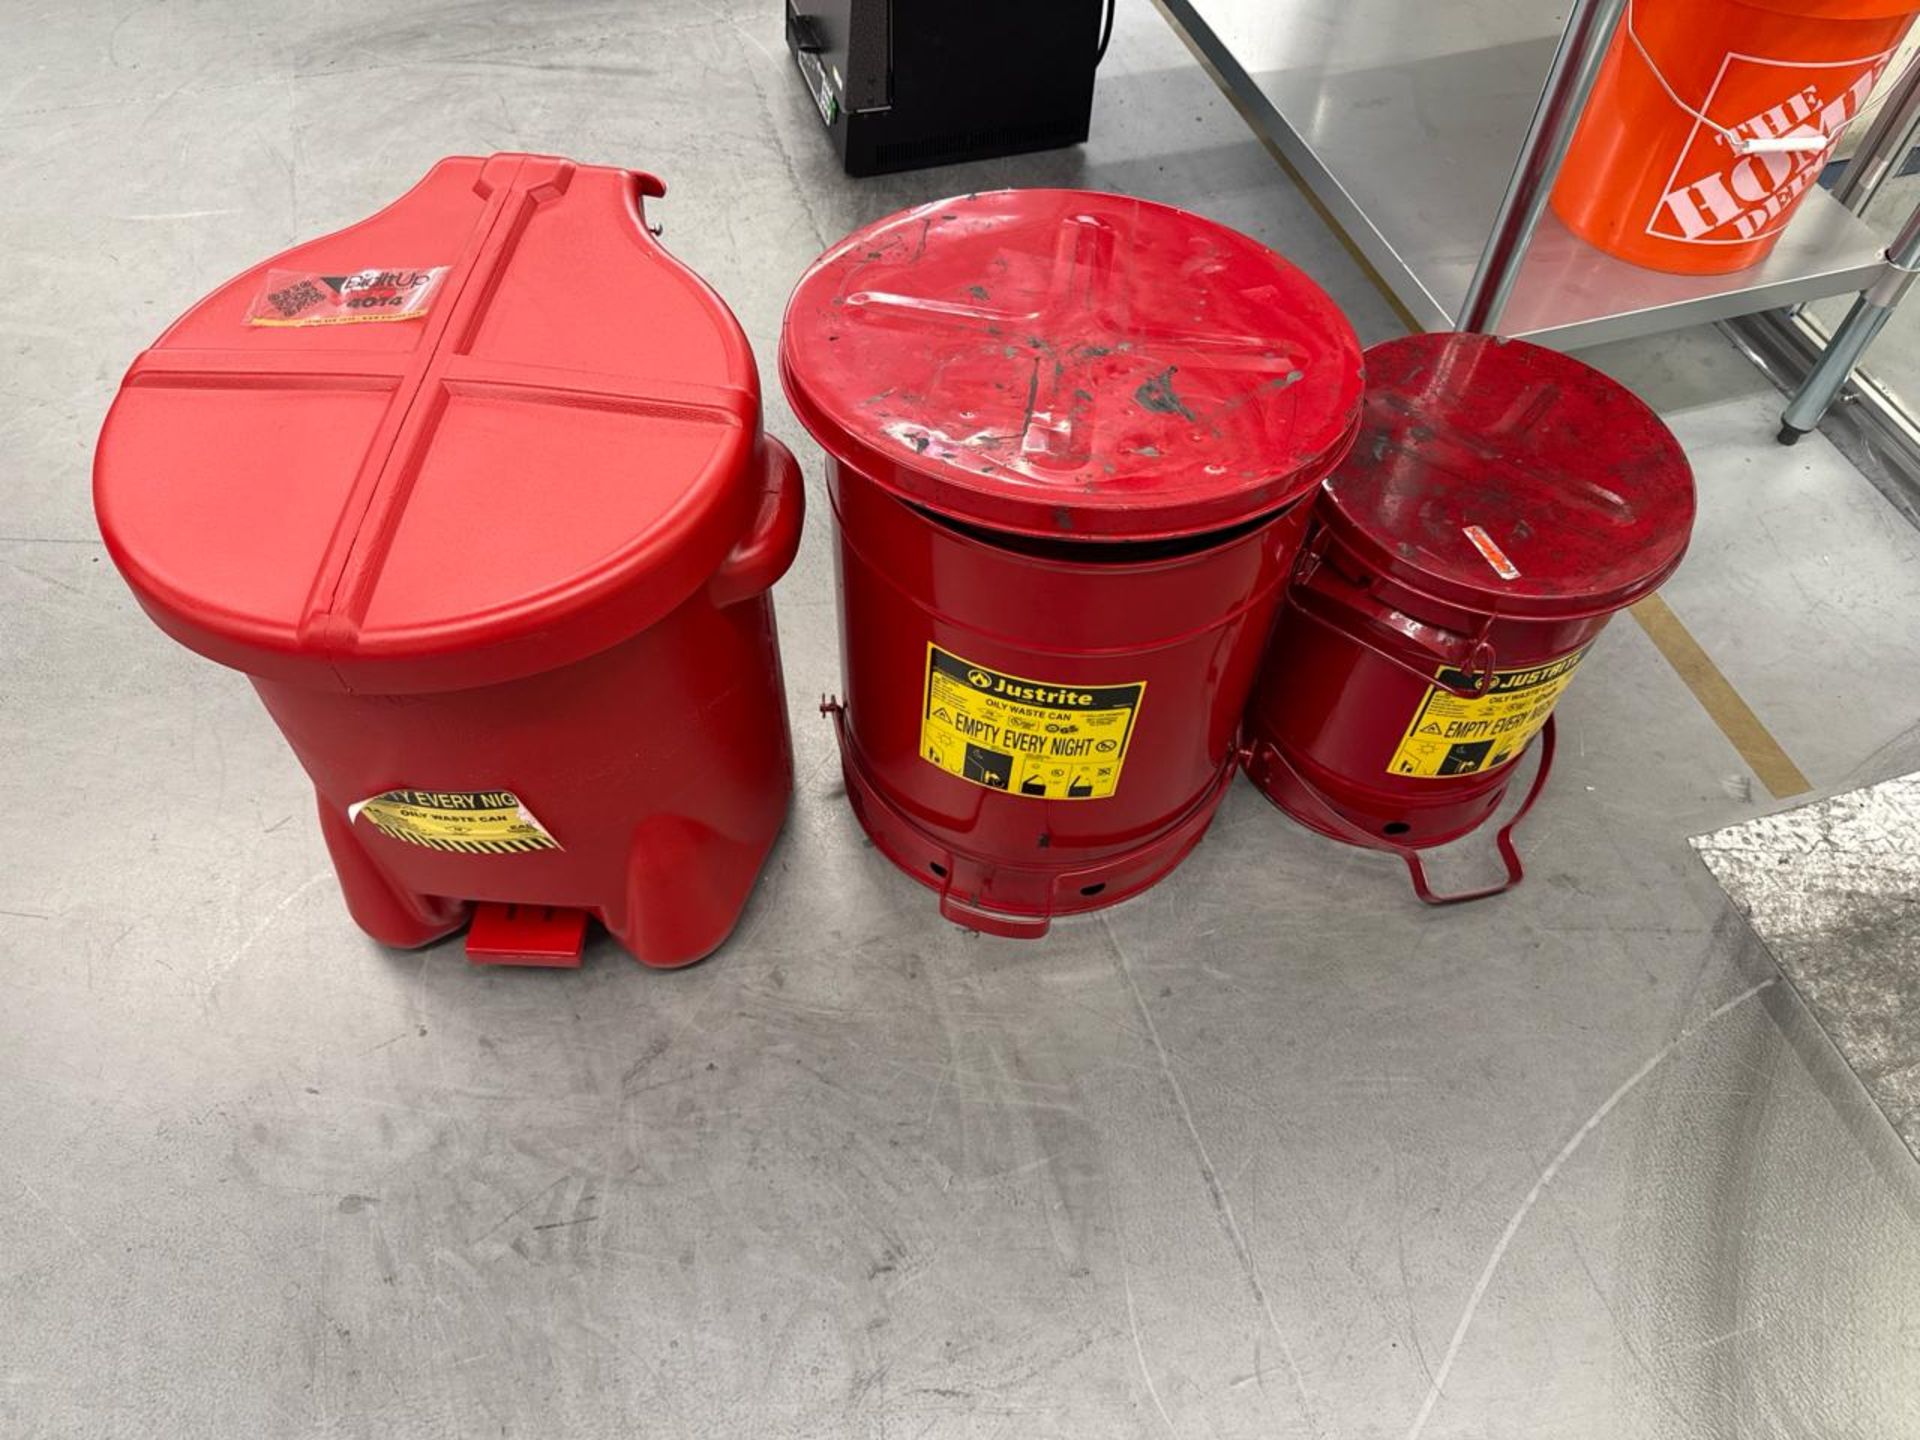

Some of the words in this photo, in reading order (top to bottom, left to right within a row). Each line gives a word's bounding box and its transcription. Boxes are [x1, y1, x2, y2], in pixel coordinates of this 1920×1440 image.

[1714, 85, 1823, 157] THE
[994, 679, 1094, 706] Justrite
[986, 698, 1008, 711] OILY
[1009, 704, 1046, 718] WASTE
[1048, 711, 1072, 721] CAN
[955, 712, 1000, 744] EMPTY
[1002, 729, 1047, 755] EVERY
[1050, 737, 1095, 757] NIGHT
[1444, 718, 1493, 739] EMPTY
[1493, 711, 1531, 735] EVERY
[414, 791, 479, 809] EVERY
[481, 791, 516, 807] NIG
[400, 809, 429, 818] OILY
[431, 813, 476, 823] WASTE
[479, 815, 508, 823] CAN
